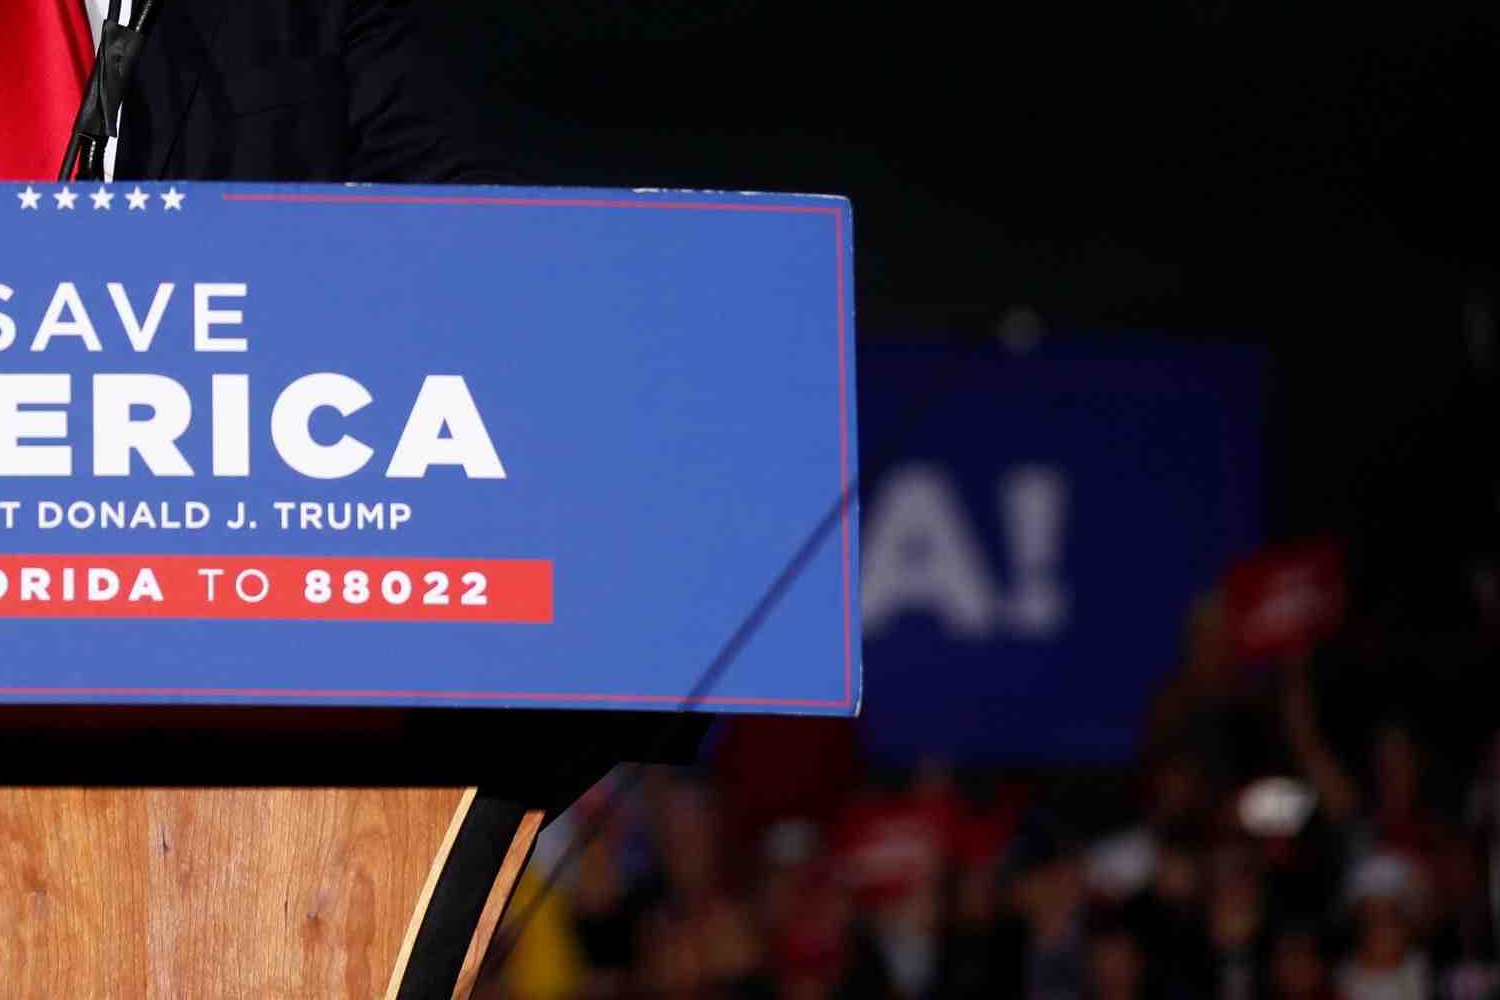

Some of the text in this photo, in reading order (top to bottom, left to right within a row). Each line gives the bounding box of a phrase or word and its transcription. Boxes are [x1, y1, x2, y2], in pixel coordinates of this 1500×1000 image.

[38, 500, 211, 529] DONALD
[226, 501, 258, 530] J.
[273, 501, 412, 531] TRUMP
[197, 568, 270, 603] TO
[304, 569, 488, 606] 88022
